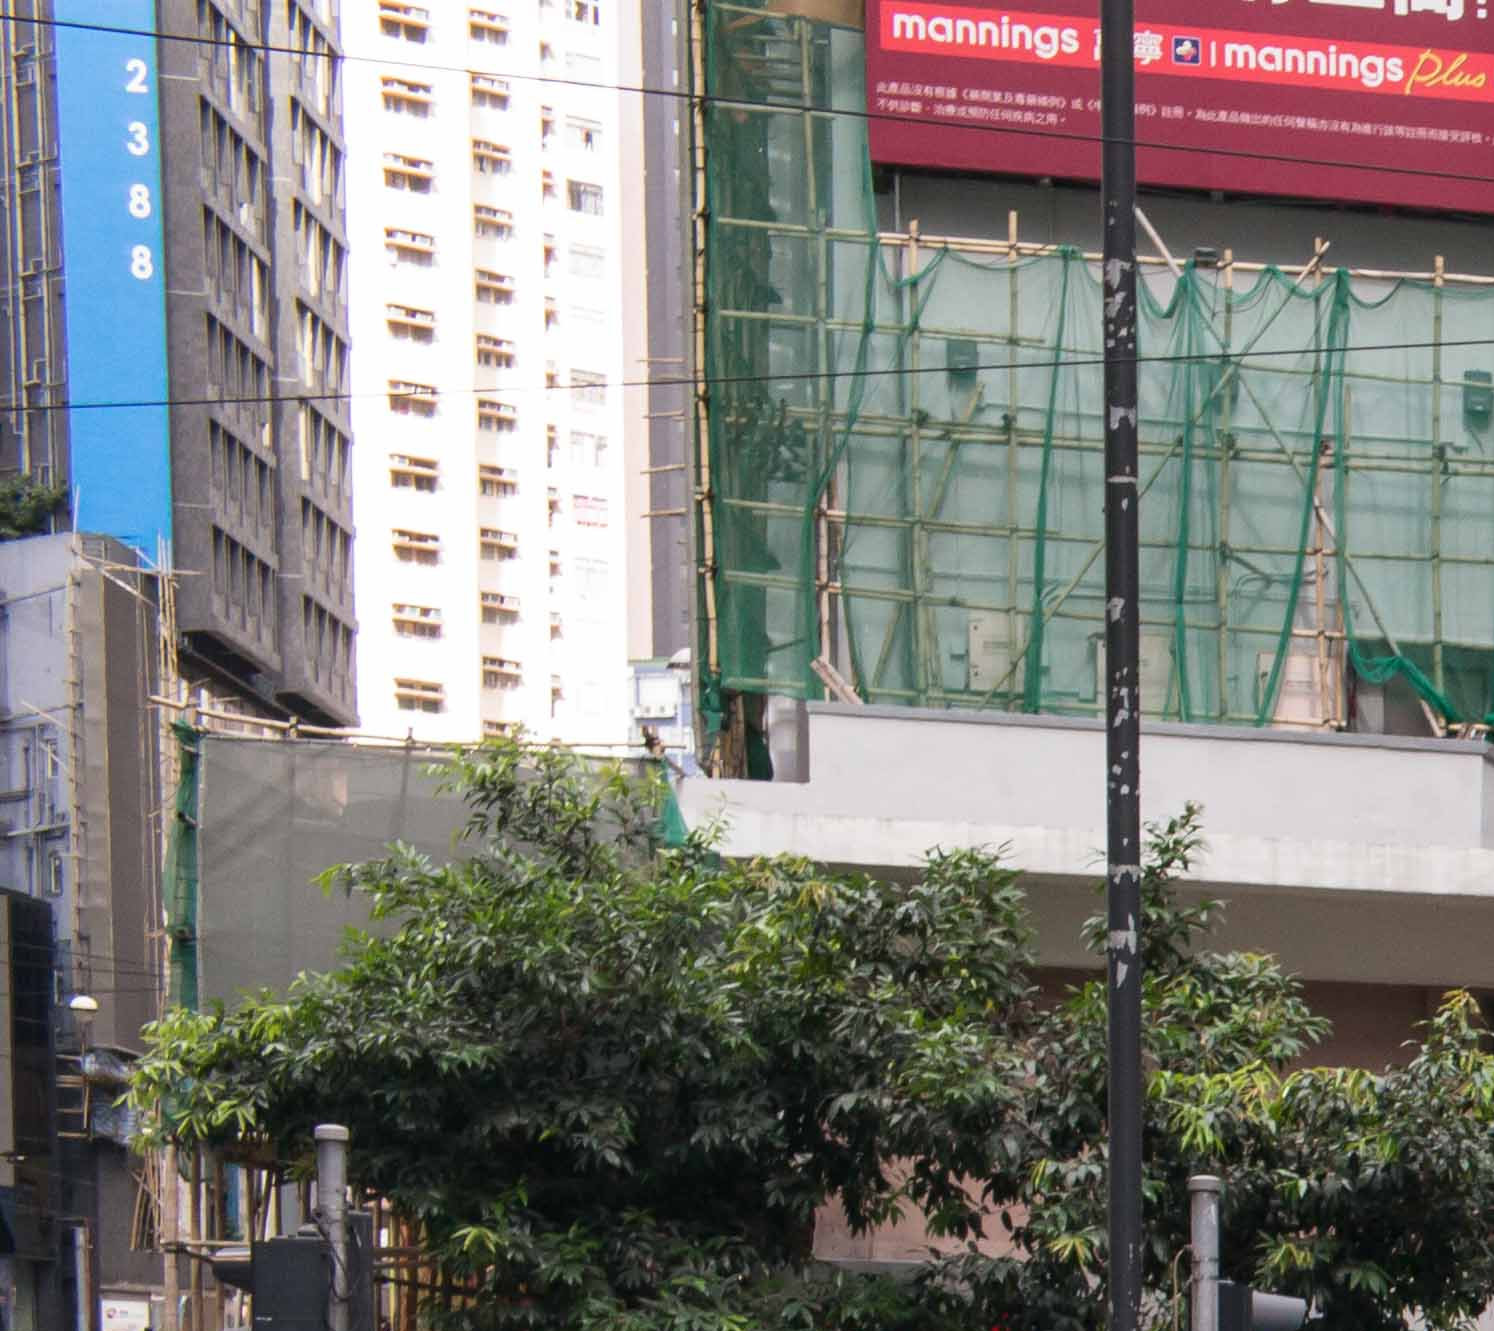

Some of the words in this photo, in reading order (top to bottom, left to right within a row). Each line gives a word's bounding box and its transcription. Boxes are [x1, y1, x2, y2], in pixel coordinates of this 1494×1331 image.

[893, 12, 1079, 59] mannings
[1093, 28, 1163, 65] 寧
[1225, 41, 1404, 87] mannings
[1406, 48, 1487, 96] Plus
[125, 58, 153, 279] 2388
